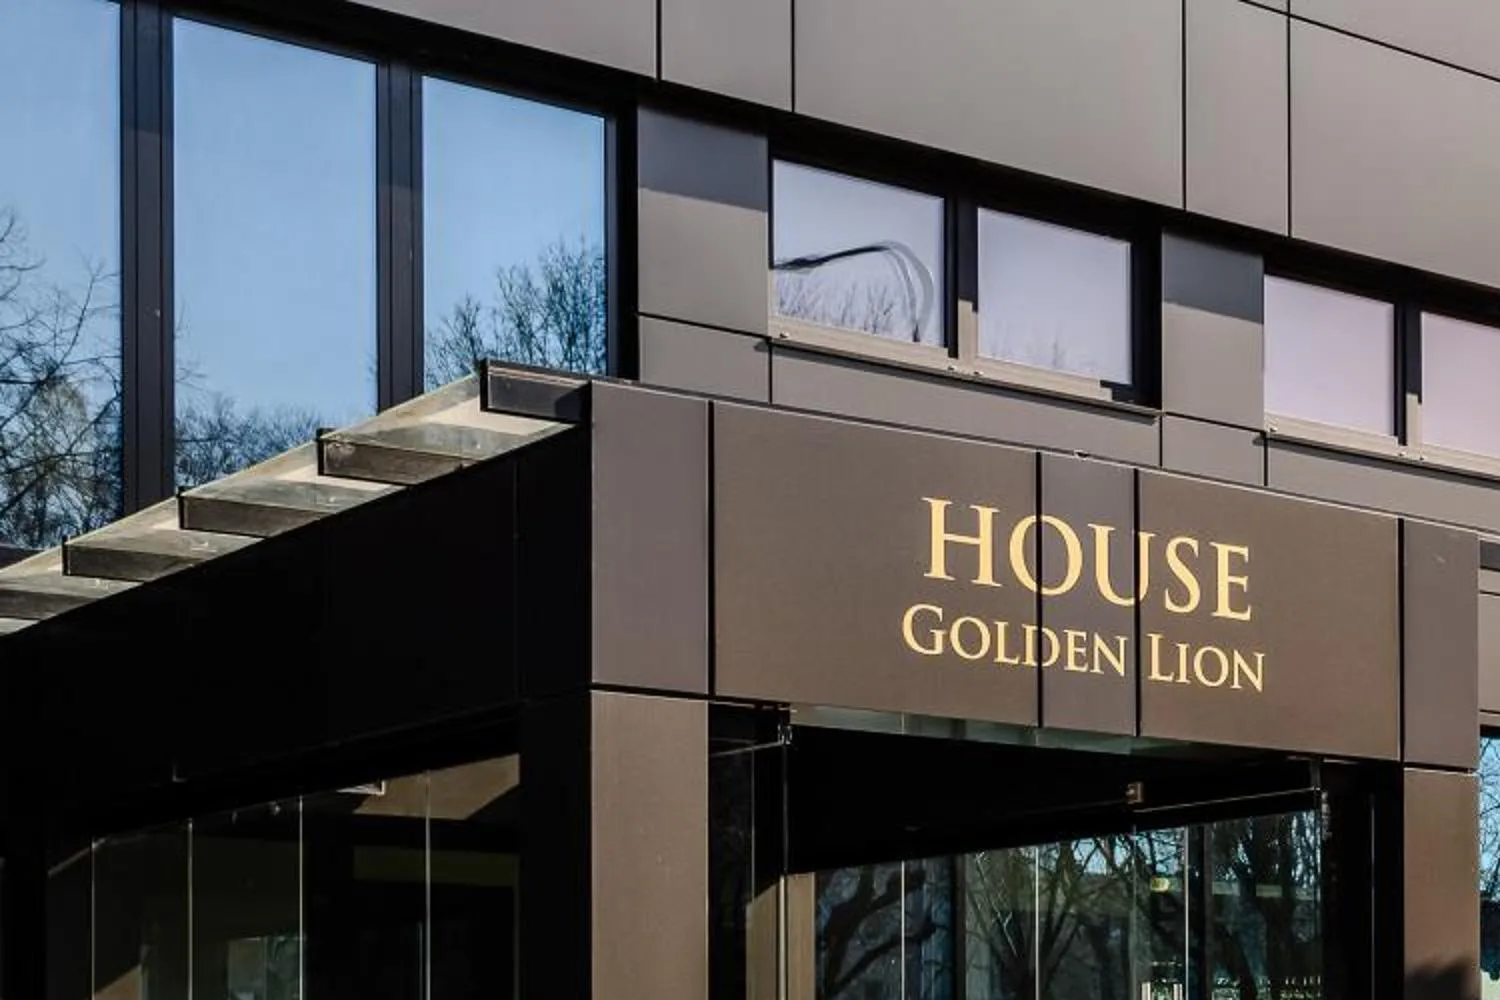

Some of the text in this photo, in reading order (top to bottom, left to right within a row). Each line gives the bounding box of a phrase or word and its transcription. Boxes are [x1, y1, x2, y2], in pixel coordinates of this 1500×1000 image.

[921, 496, 1252, 622] HOUSE
[902, 603, 1266, 693] GOLDEN LION
